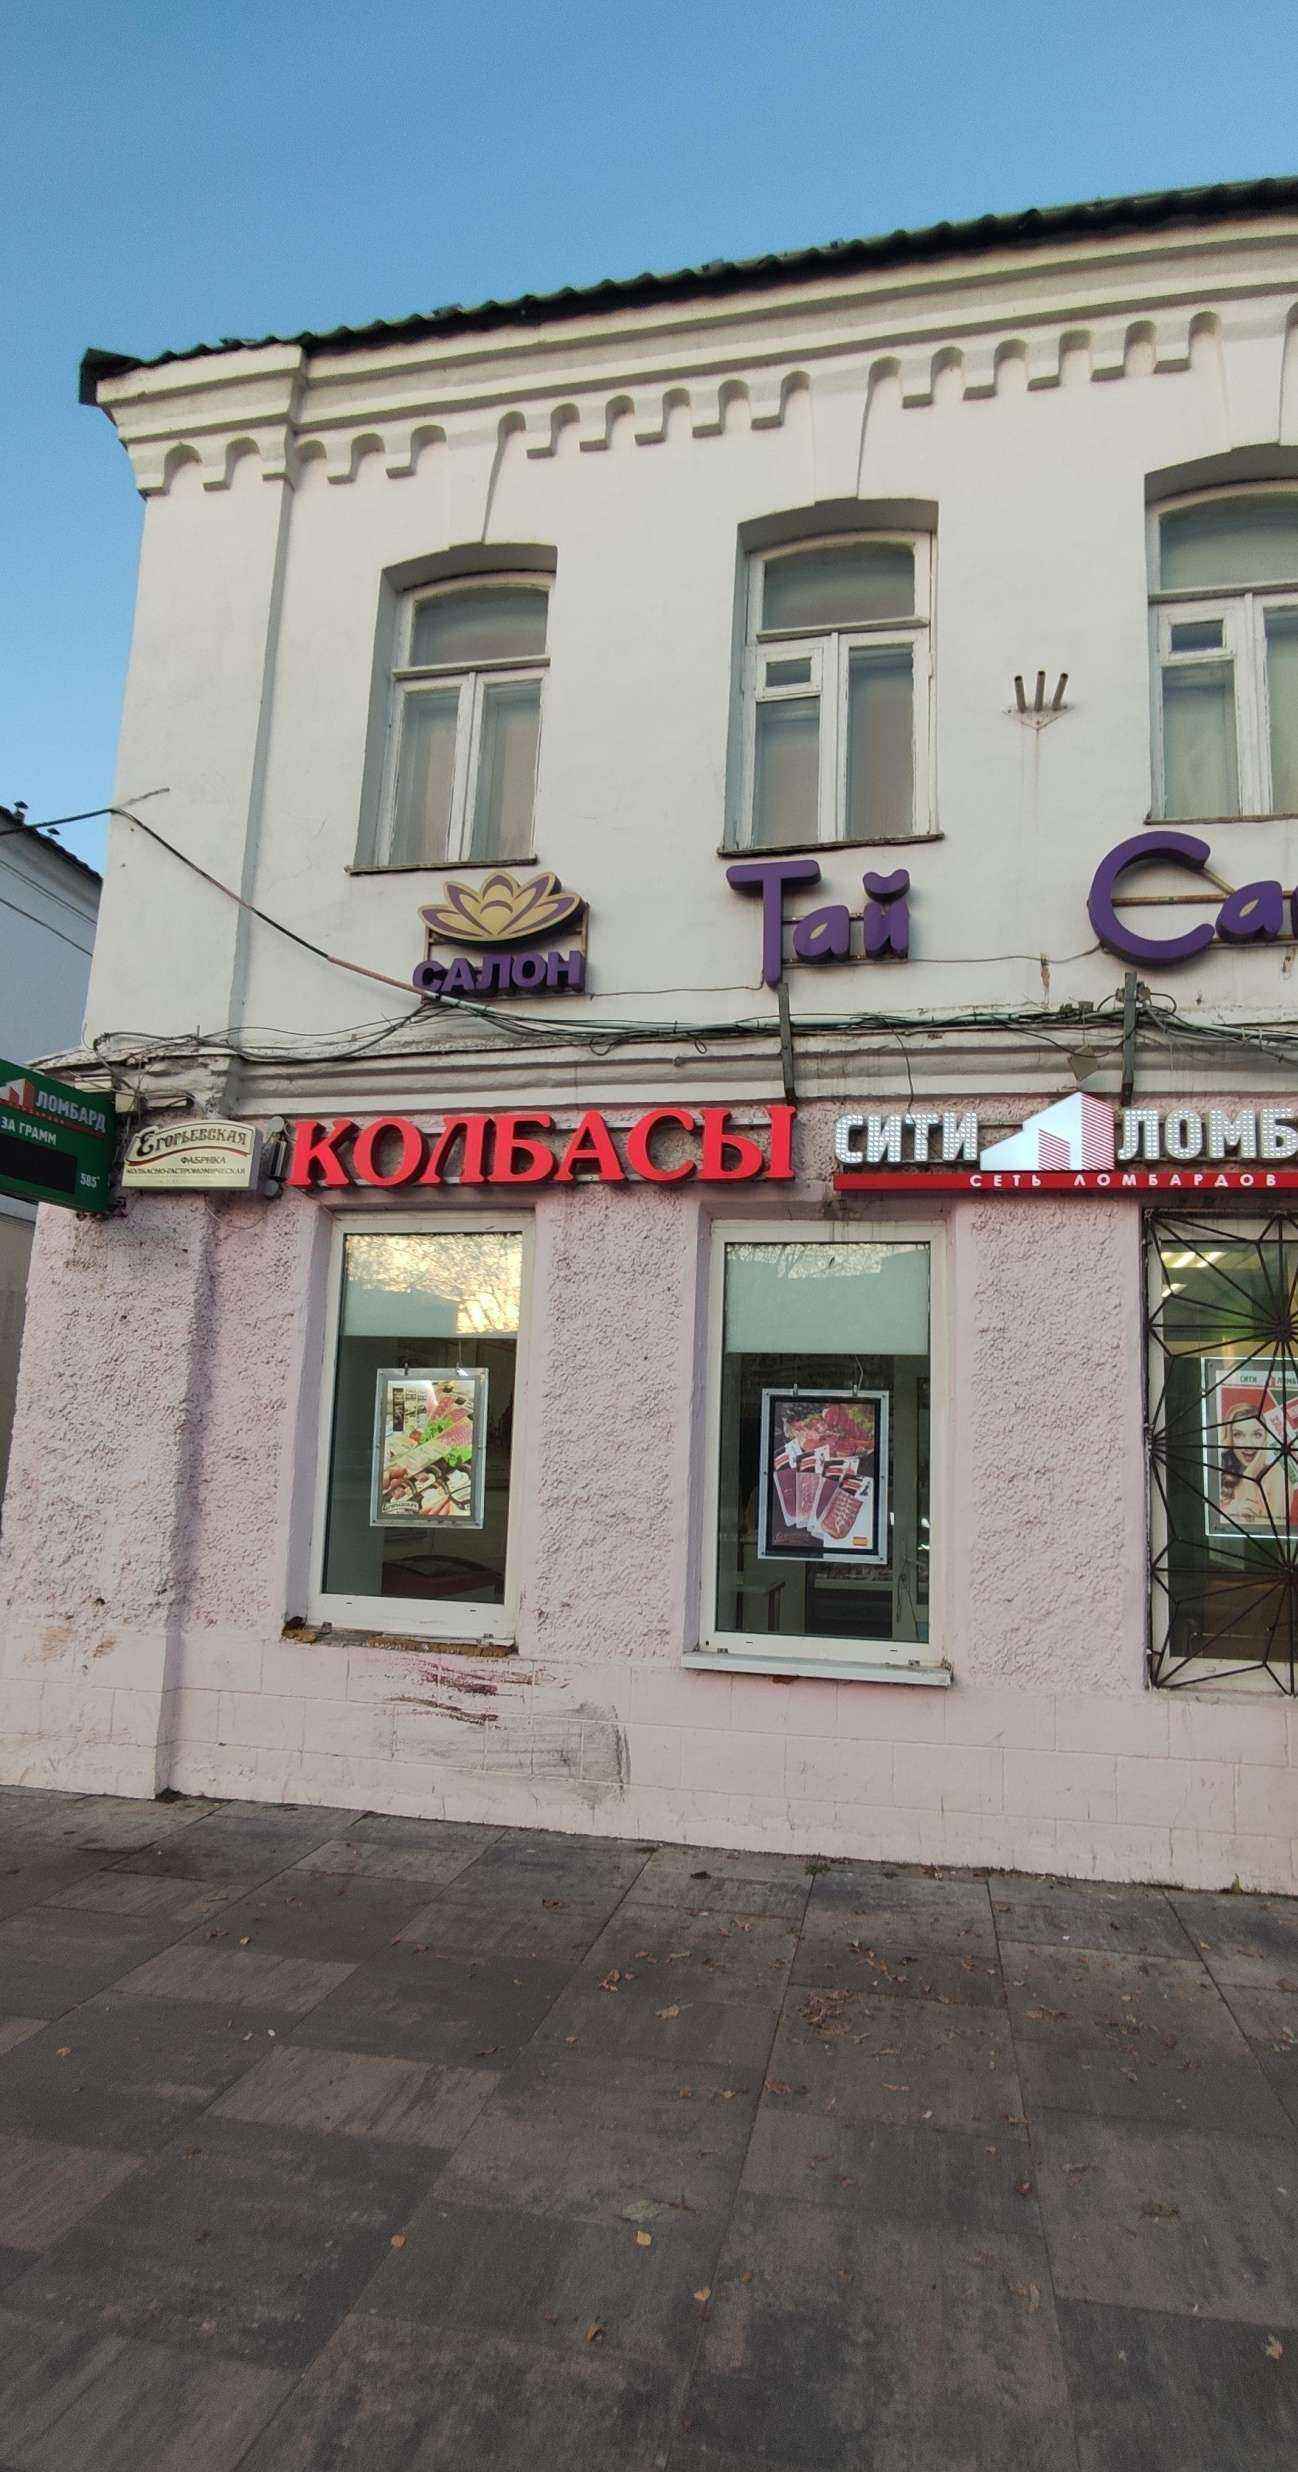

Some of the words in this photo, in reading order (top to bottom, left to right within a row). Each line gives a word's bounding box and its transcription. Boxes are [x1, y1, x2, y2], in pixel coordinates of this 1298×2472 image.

[726, 859, 911, 990] Тай
[1087, 831, 1298, 967] Са
[412, 950, 586, 992] САЛОН
[0, 1116, 16, 1133] ЗА
[19, 1122, 57, 1146] ГРАММ
[36, 1090, 107, 1134] ЛОМБАРД
[287, 1105, 797, 1187] КОЛБАСЫ
[835, 1111, 978, 1164] СИТИ
[969, 1173, 1042, 1187] СЕТЬ
[1074, 1173, 1277, 1187] ЛОМБАРДОВ
